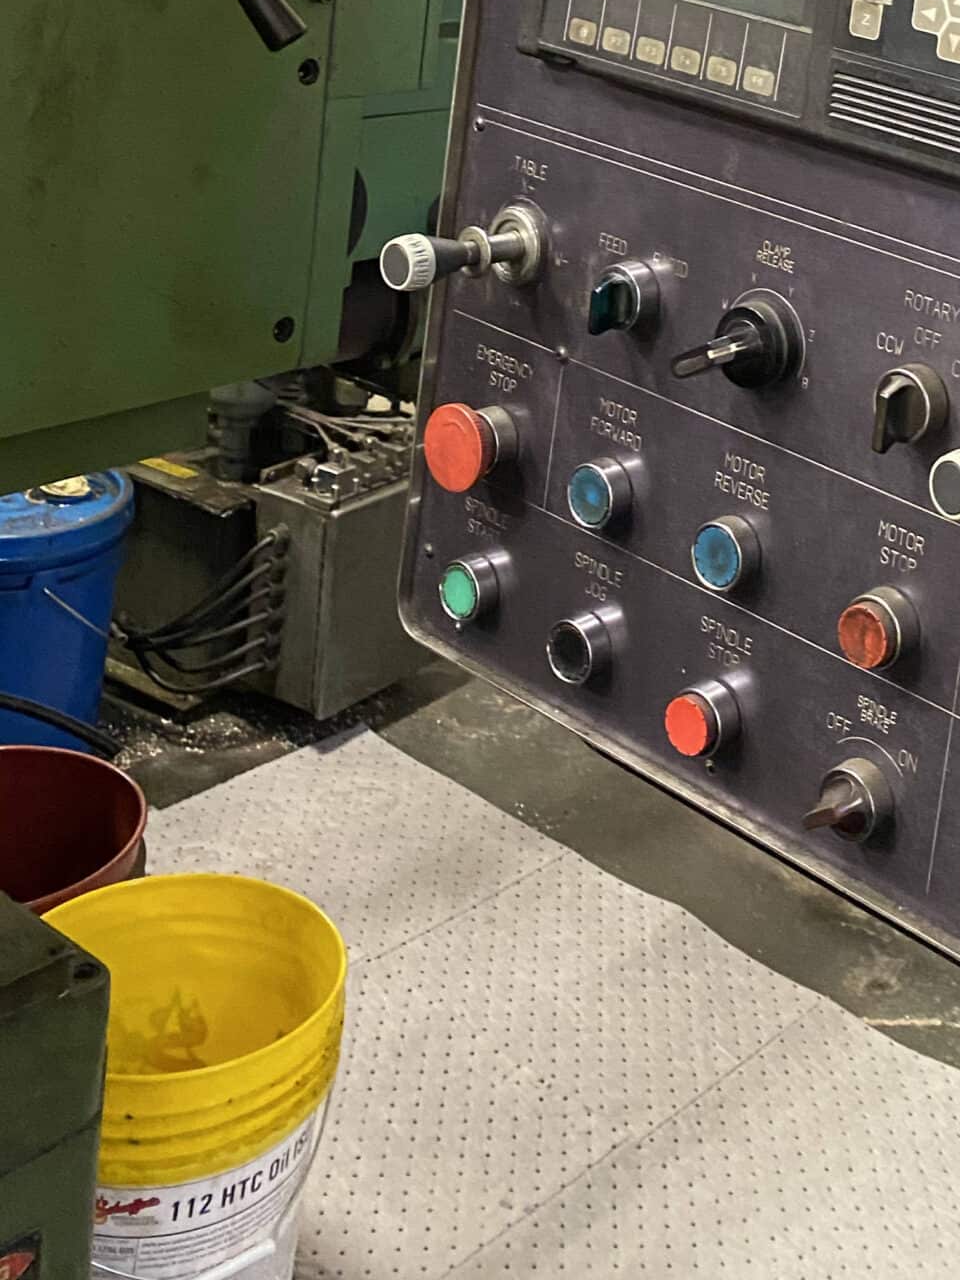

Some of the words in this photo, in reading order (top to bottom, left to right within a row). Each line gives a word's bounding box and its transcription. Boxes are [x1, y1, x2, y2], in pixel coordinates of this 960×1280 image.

[861, 13, 871, 26] Z
[515, 155, 549, 181] TABLE
[598, 232, 628, 256] FEED
[762, 239, 791, 259] CLAMP
[756, 249, 795, 274] RELEASE
[876, 331, 905, 356] CCW
[914, 326, 942, 350] OFF
[476, 343, 534, 380] EMERGENCY
[488, 370, 518, 393] STOP
[599, 398, 638, 426] MOTOR
[590, 416, 643, 452] FORWARD
[723, 452, 766, 484] MOTOR
[714, 473, 770, 511] REVERSE
[878, 520, 926, 557] MOTOR
[574, 551, 624, 587] SPINDLE
[879, 546, 918, 572] STOP
[585, 581, 608, 602] JOG
[700, 615, 753, 656] SPINDLE
[709, 640, 740, 666] STOP
[857, 694, 898, 721] SPINDLE
[826, 711, 853, 735] OFF
[899, 748, 918, 772] ON
[171, 1193, 213, 1222] 112
[221, 1170, 263, 1208] HTC
[269, 1147, 290, 1181] Oil
